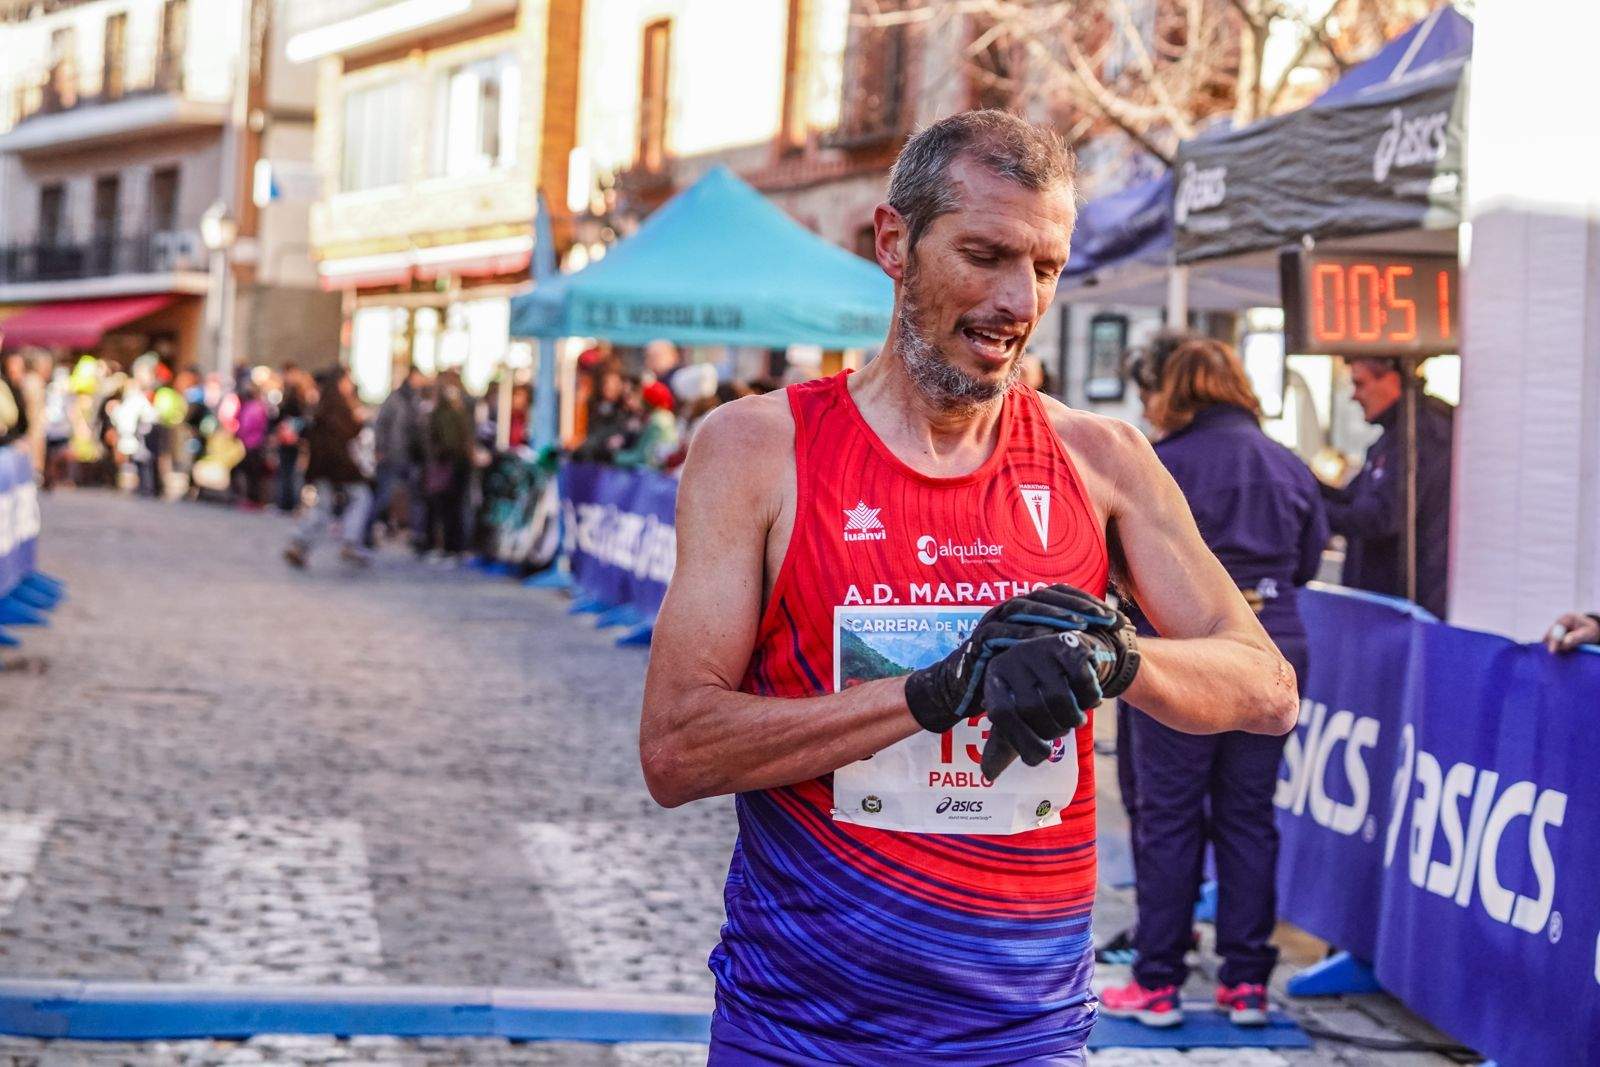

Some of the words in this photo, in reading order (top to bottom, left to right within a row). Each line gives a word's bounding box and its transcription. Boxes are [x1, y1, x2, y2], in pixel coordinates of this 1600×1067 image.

[939, 537, 1004, 564] alquiber
[843, 583, 900, 606] A.D.
[910, 580, 1069, 604] MARATH
[851, 618, 931, 632] CARRERA
[935, 621, 953, 632] DE
[957, 618, 980, 632] NA
[928, 771, 995, 788] PABLO
